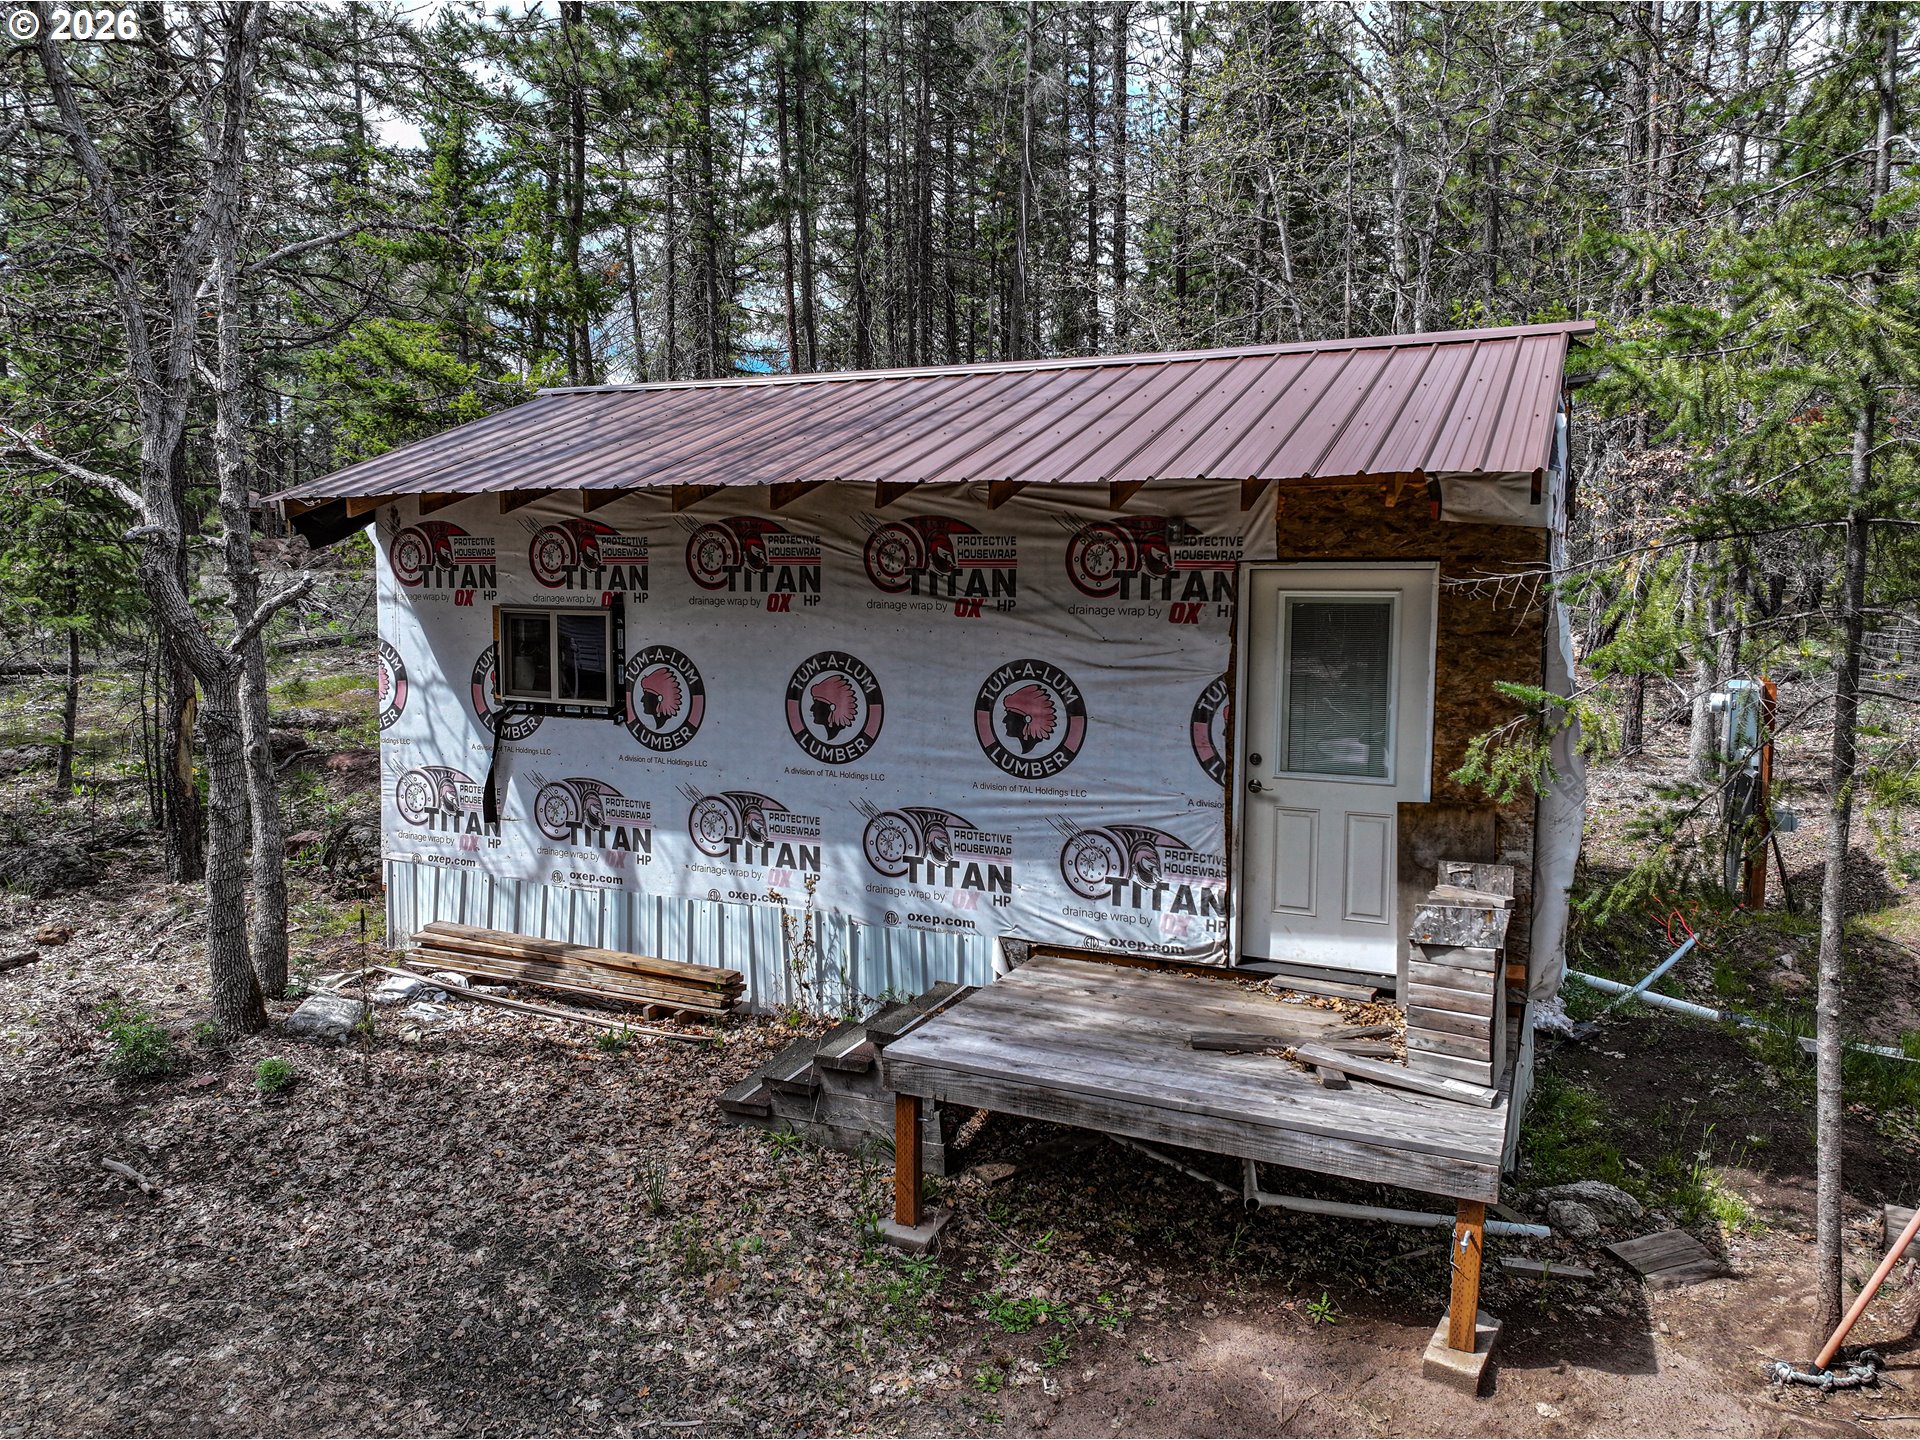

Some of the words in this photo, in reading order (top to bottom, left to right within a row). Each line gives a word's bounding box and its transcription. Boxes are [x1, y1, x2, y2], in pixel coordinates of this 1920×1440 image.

[454, 537, 495, 546] PROTECTIVE
[601, 537, 648, 546] PROTECTIVE
[768, 535, 820, 545] PROTECTIVE
[957, 535, 1017, 547] PROTECTIVE
[1184, 536, 1244, 547] ROTECTIVE
[454, 548, 496, 557] HOUSEWRAP
[601, 548, 648, 556] HOUSEWRAP
[768, 547, 821, 557] HOUSEWRAP
[957, 549, 1017, 559] HOUSEWRAP
[1174, 549, 1244, 561] HOUSEWRAP
[419, 565, 497, 589] TITAN
[561, 565, 648, 591] TITAN
[722, 565, 821, 593] TITAN
[905, 567, 1017, 598] TITAN
[1113, 570, 1234, 602] TITAN
[454, 589, 475, 607] OX
[483, 590, 497, 601] HP
[532, 593, 565, 605] drainage
[566, 595, 585, 605] wrap
[586, 593, 596, 605] by
[601, 591, 618, 608] O
[634, 592, 648, 603] HP
[688, 595, 725, 608] drainage
[726, 598, 749, 608] wrap
[750, 596, 761, 608] by
[767, 593, 792, 613] OX
[804, 595, 821, 607] HP
[866, 599, 907, 612] drainage
[909, 602, 933, 613] wrap
[935, 600, 948, 613] by
[954, 598, 985, 618] OX
[997, 600, 1016, 612] HP
[1068, 604, 1115, 618] drainage
[1117, 607, 1145, 619] wrap
[1148, 605, 1162, 619] by
[1168, 602, 1202, 625] OX
[1217, 605, 1233, 618] H
[625, 648, 699, 685] TUM-A-LUM
[791, 654, 877, 694] TUM-A-LUM
[981, 663, 1079, 705] TUM-A-LUM
[632, 723, 693, 750] LUMBER
[516, 746, 538, 756] Holdings
[539, 748, 552, 756] LLC
[800, 733, 869, 762] LUMBER
[624, 754, 645, 763] division
[646, 755, 653, 764] of
[653, 756, 665, 765] TAL
[667, 757, 693, 767] Holdings
[991, 747, 1069, 777] LUMBER
[791, 767, 815, 777] division
[817, 769, 824, 777] of
[825, 769, 838, 778] TAL
[840, 771, 869, 782] Holdings
[870, 773, 885, 781] LLC
[980, 782, 1007, 791] division
[1009, 784, 1017, 792] of
[1035, 786, 1068, 797] Holdings
[1070, 789, 1087, 798] LLC
[605, 798, 651, 810] PROTECTIVE
[1187, 799, 1194, 807] A
[424, 807, 501, 837] TITAN
[606, 809, 651, 820] HOUSEWRAP
[769, 812, 820, 826] PROTECTIVE
[566, 821, 652, 854] TITAN
[769, 824, 821, 837] HOUSEWRAP
[954, 830, 1012, 844] PROTECTIVE
[398, 830, 427, 842] drainage
[428, 833, 445, 844] wrap
[446, 835, 455, 847] by
[488, 838, 501, 849] HP
[537, 846, 568, 859] drainage
[570, 850, 589, 861] wrap
[590, 851, 600, 862] by
[605, 850, 627, 869] OX
[637, 854, 652, 866] HP
[724, 837, 821, 872] TITAN
[954, 842, 1012, 856] HOUSEWRAP
[428, 854, 476, 867] oxep.com
[1165, 850, 1226, 867] PROTECTIVE
[569, 871, 623, 885] oxep.com
[691, 863, 727, 876] drainage
[728, 867, 749, 879] wrap
[751, 868, 762, 881] by
[768, 868, 793, 888] OX
[804, 873, 821, 884] HP
[902, 856, 1012, 894] TITAN
[1164, 863, 1226, 879] HOUSEWRAP
[728, 890, 789, 905] oxep.com
[865, 882, 905, 896] drainage
[908, 889, 930, 900] wrap
[934, 890, 946, 903] by
[952, 889, 980, 910] OX
[992, 894, 1011, 908] HP
[1105, 876, 1228, 917] TITAN
[908, 912, 976, 929] oxep.com
[1062, 905, 1108, 922] drainage
[1110, 913, 1137, 926] wrap
[1139, 914, 1153, 927] by
[1206, 919, 1227, 933] HP
[1109, 937, 1186, 955] oxep.com
